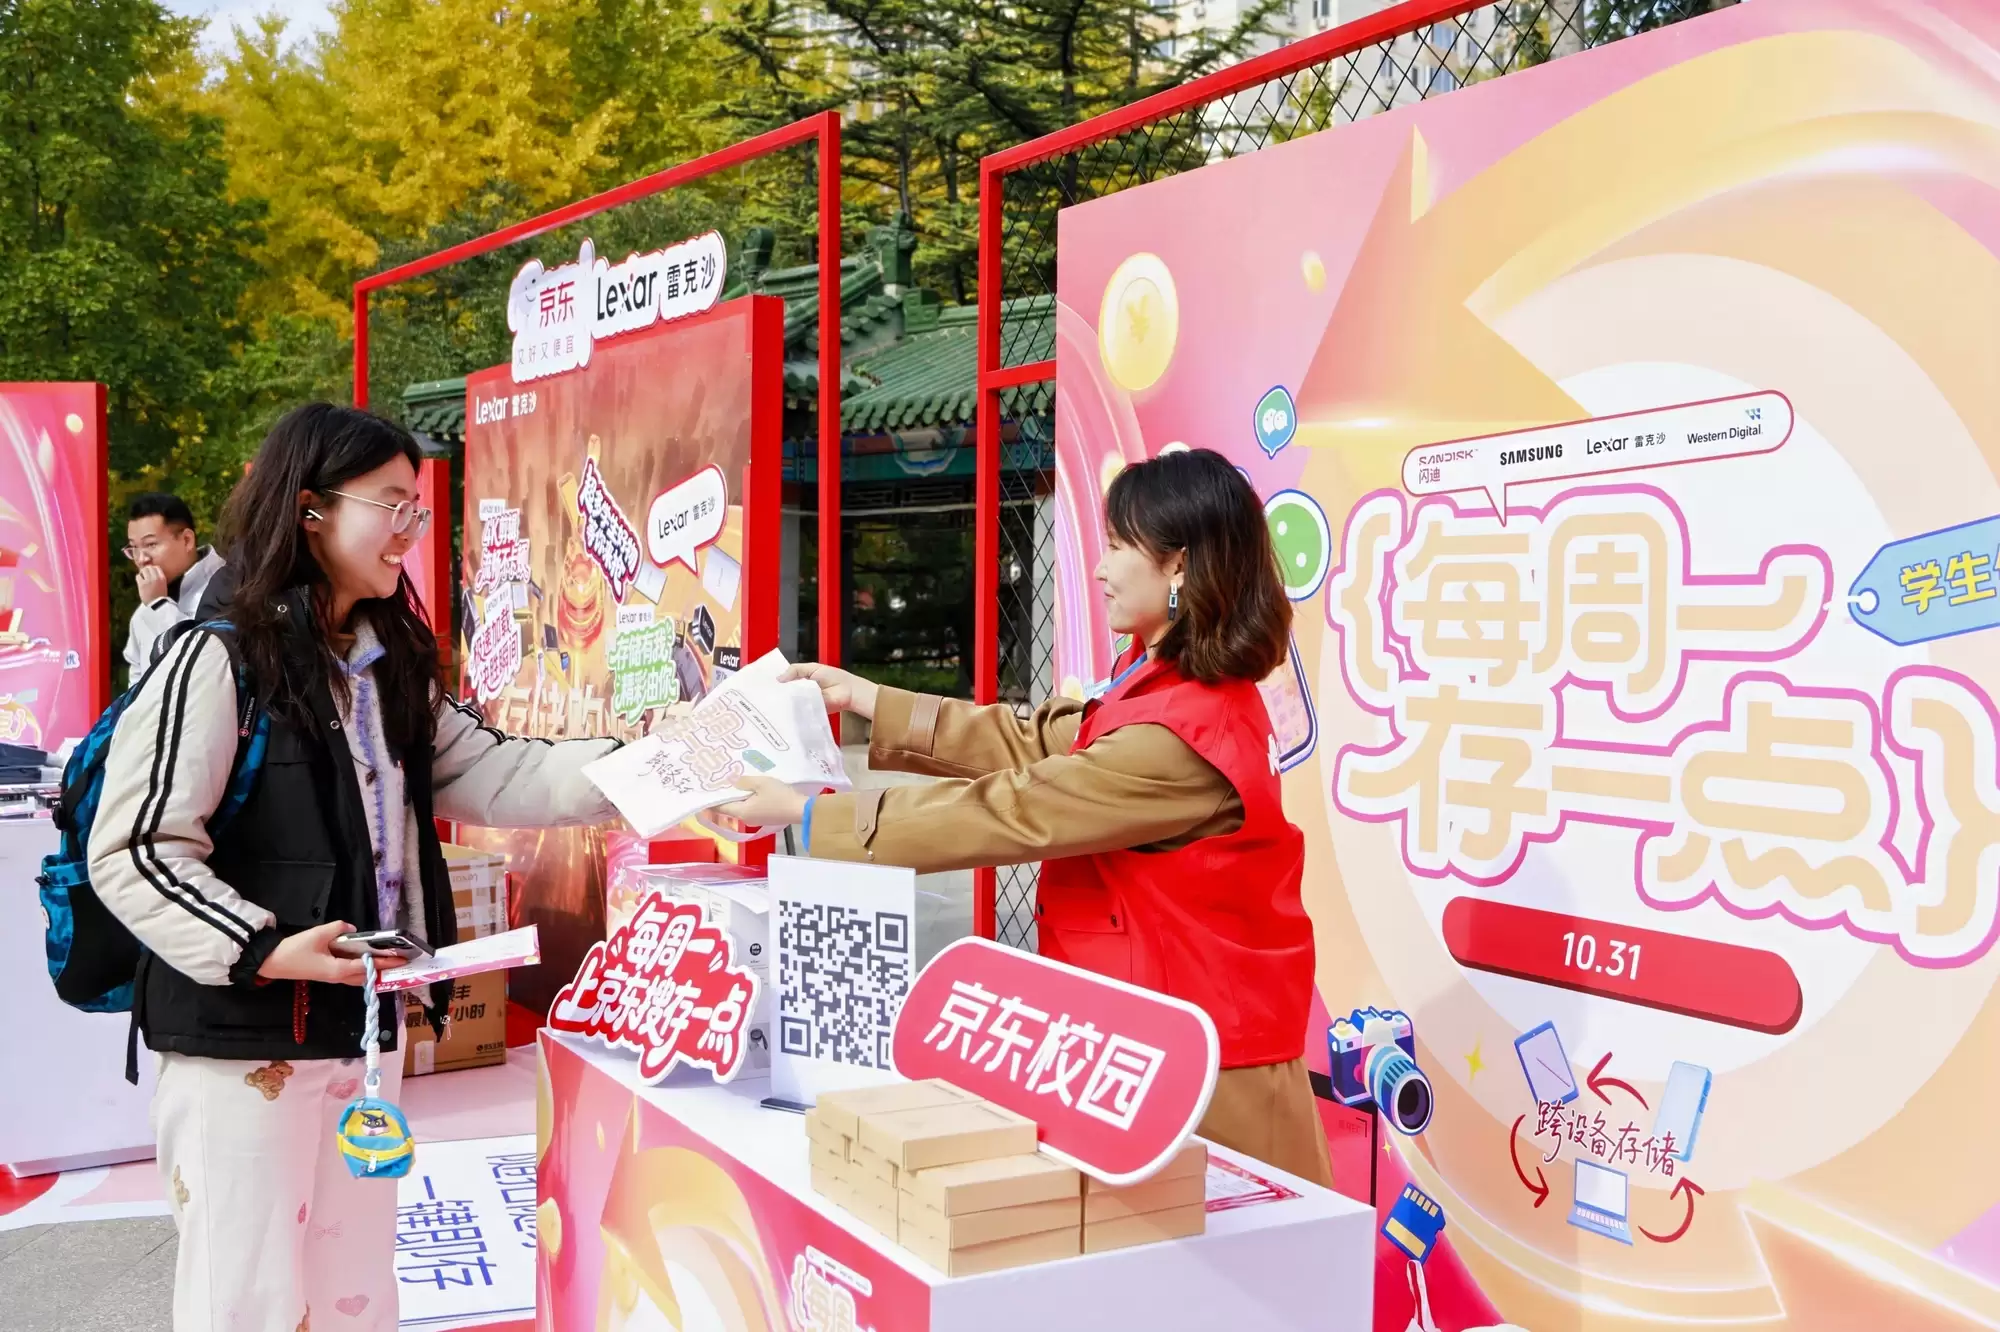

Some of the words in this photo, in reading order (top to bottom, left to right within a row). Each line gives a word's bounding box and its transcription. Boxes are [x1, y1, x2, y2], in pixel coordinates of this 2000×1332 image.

[539, 280, 575, 328] 京东
[597, 271, 657, 321] Lexar
[667, 253, 716, 301] 雷克沙
[475, 396, 508, 424] Lexar
[512, 391, 537, 417] 雷克沙
[1500, 443, 1563, 466] SAMSUNG
[1586, 435, 1629, 455] Lexar
[1634, 432, 1666, 449] 雷克沙
[1687, 429, 1727, 444] Western
[1729, 424, 1762, 442] Digital
[1418, 468, 1441, 485] 闪迪
[658, 510, 689, 539] Lexar
[1899, 543, 2000, 615] 学生
[720, 651, 740, 668] Lexar
[626, 901, 715, 976] 每周一
[1562, 929, 1643, 983] 10.31
[555, 956, 747, 1067] 上京东搜存一点
[923, 980, 1166, 1132] 京东校园
[1534, 1099, 1681, 1177] 跨设备存储
